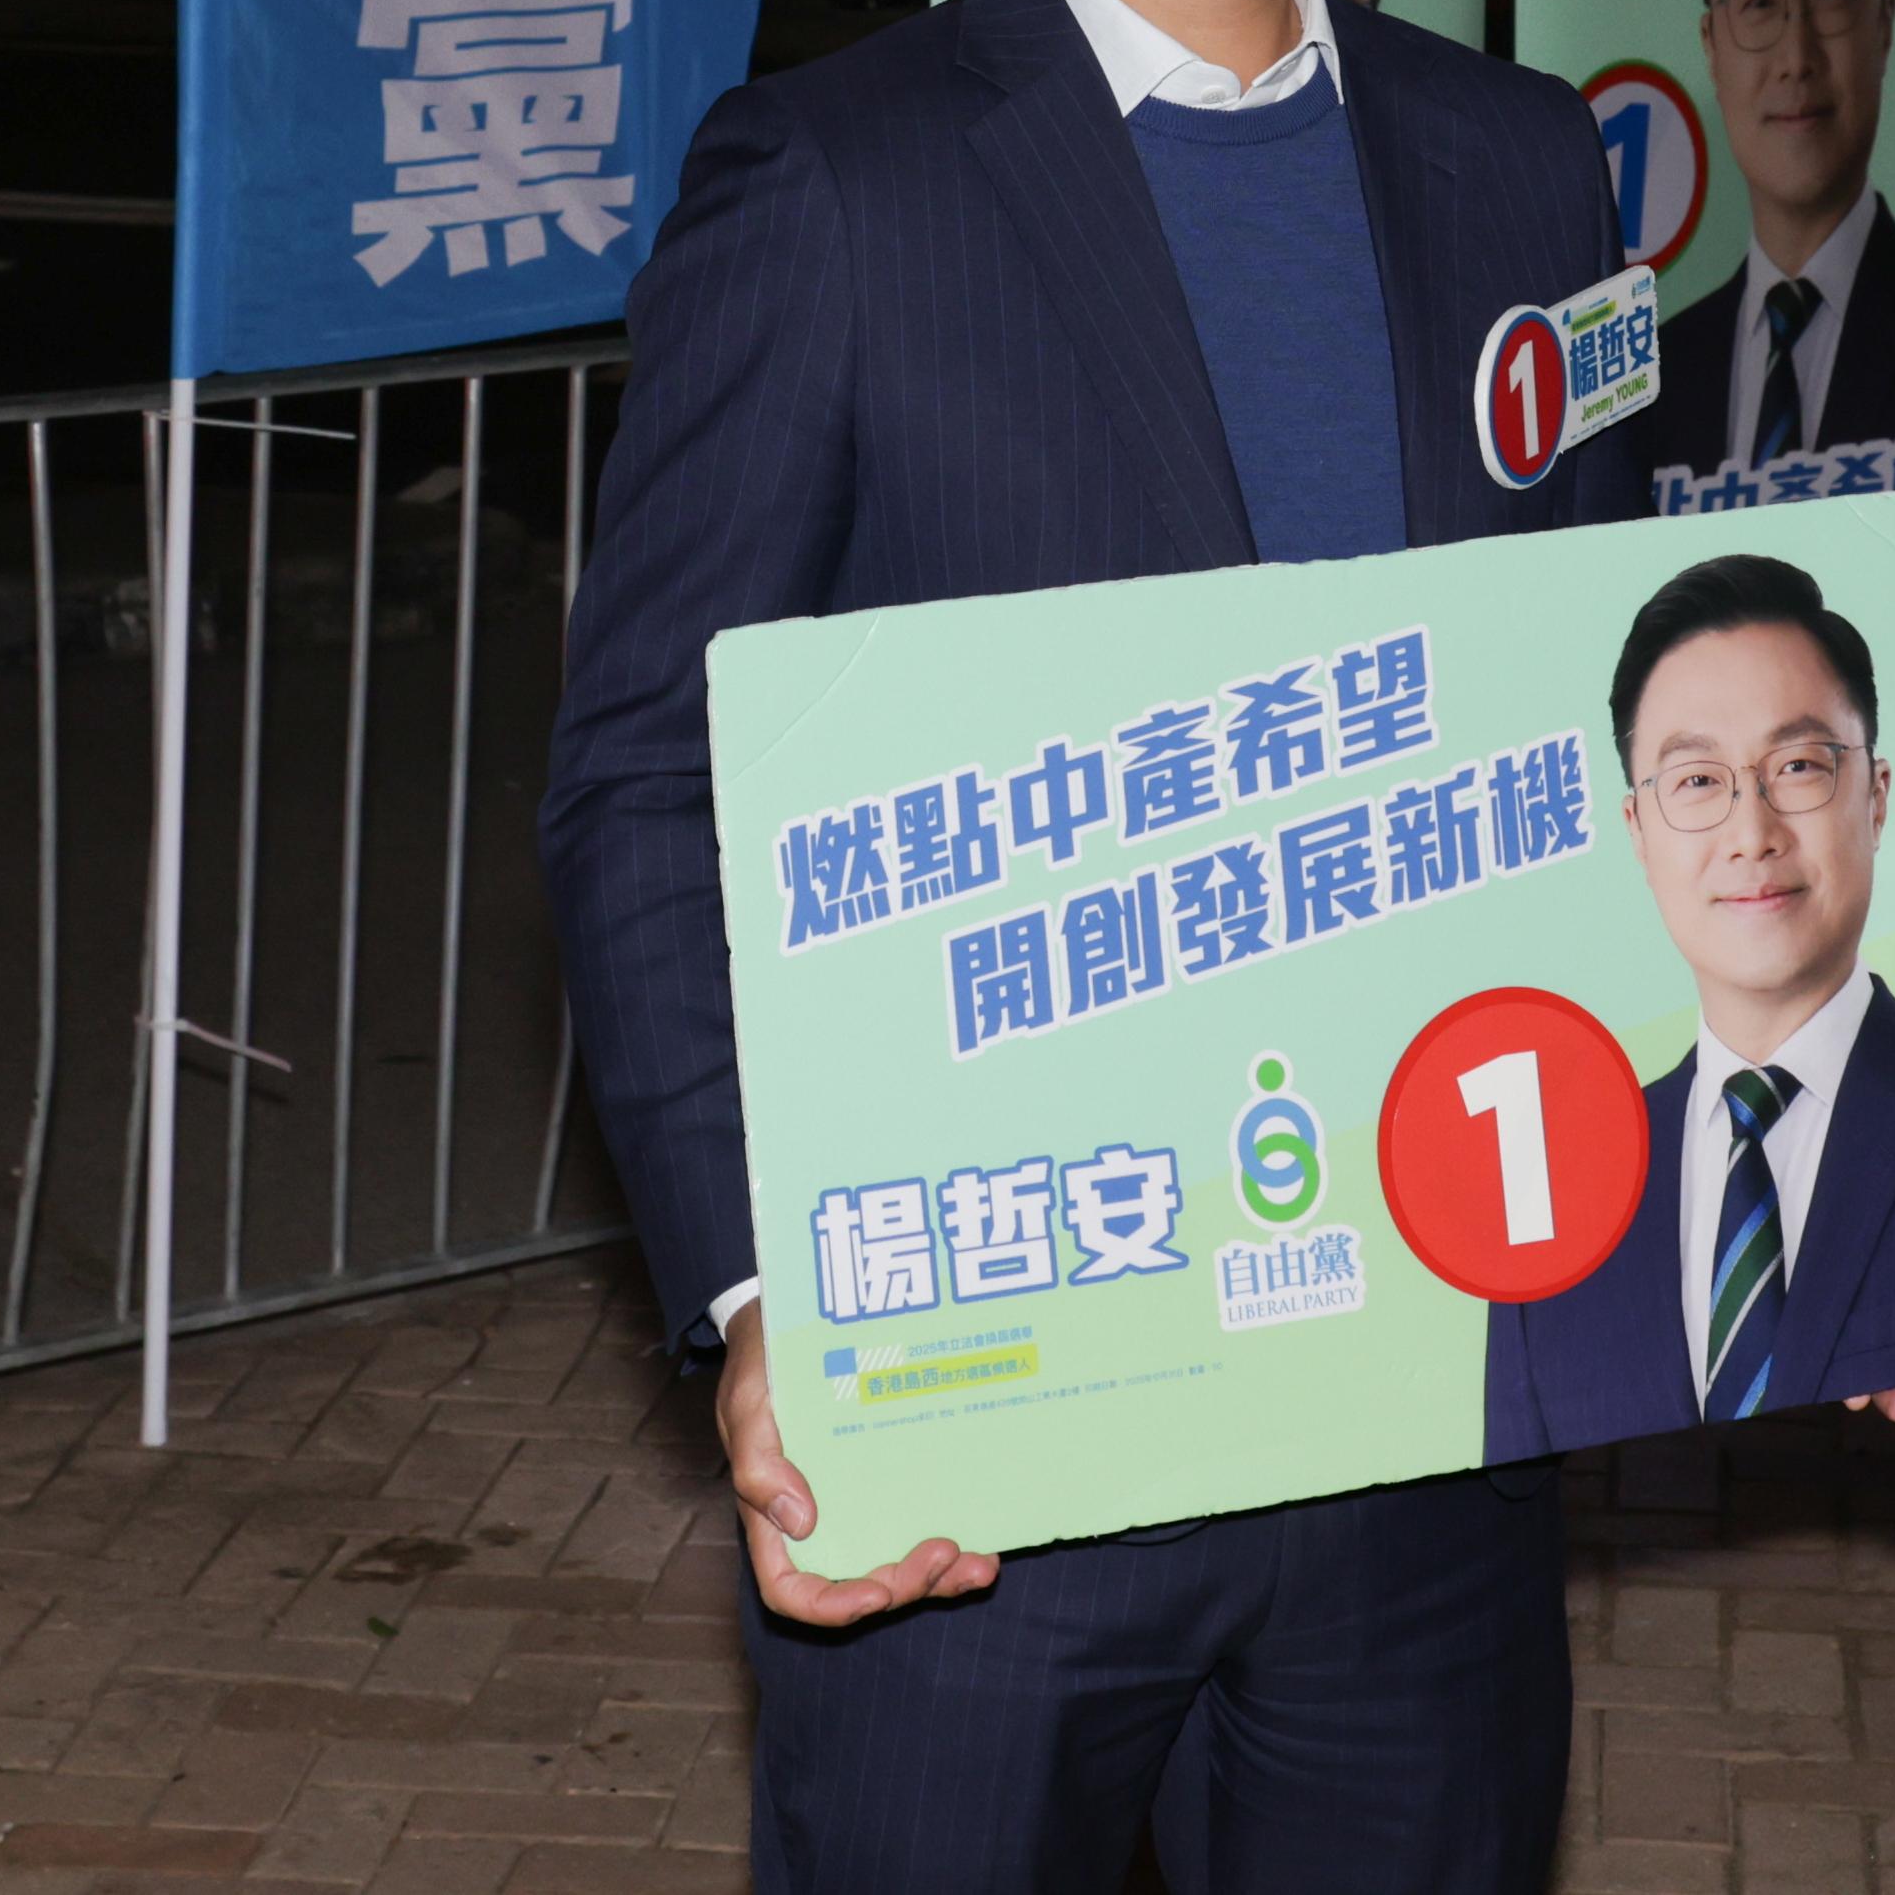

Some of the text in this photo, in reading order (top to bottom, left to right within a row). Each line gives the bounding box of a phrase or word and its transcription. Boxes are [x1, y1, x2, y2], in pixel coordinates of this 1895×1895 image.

[1601, 101, 1651, 250] 1
[1508, 339, 1540, 461] 1
[1569, 304, 1655, 403] 楊哲安
[1580, 393, 1615, 423] Jeremy
[1615, 372, 1649, 405] YOUNG
[779, 631, 1435, 950] 燃點中產希望
[947, 733, 1591, 1056] 開創發展新機
[1456, 1050, 1556, 1247] 1
[815, 1147, 1187, 1319] 楊哲安
[1221, 1232, 1357, 1300] 自由黨
[1227, 1285, 1358, 1323] LIBERAL PARTY
